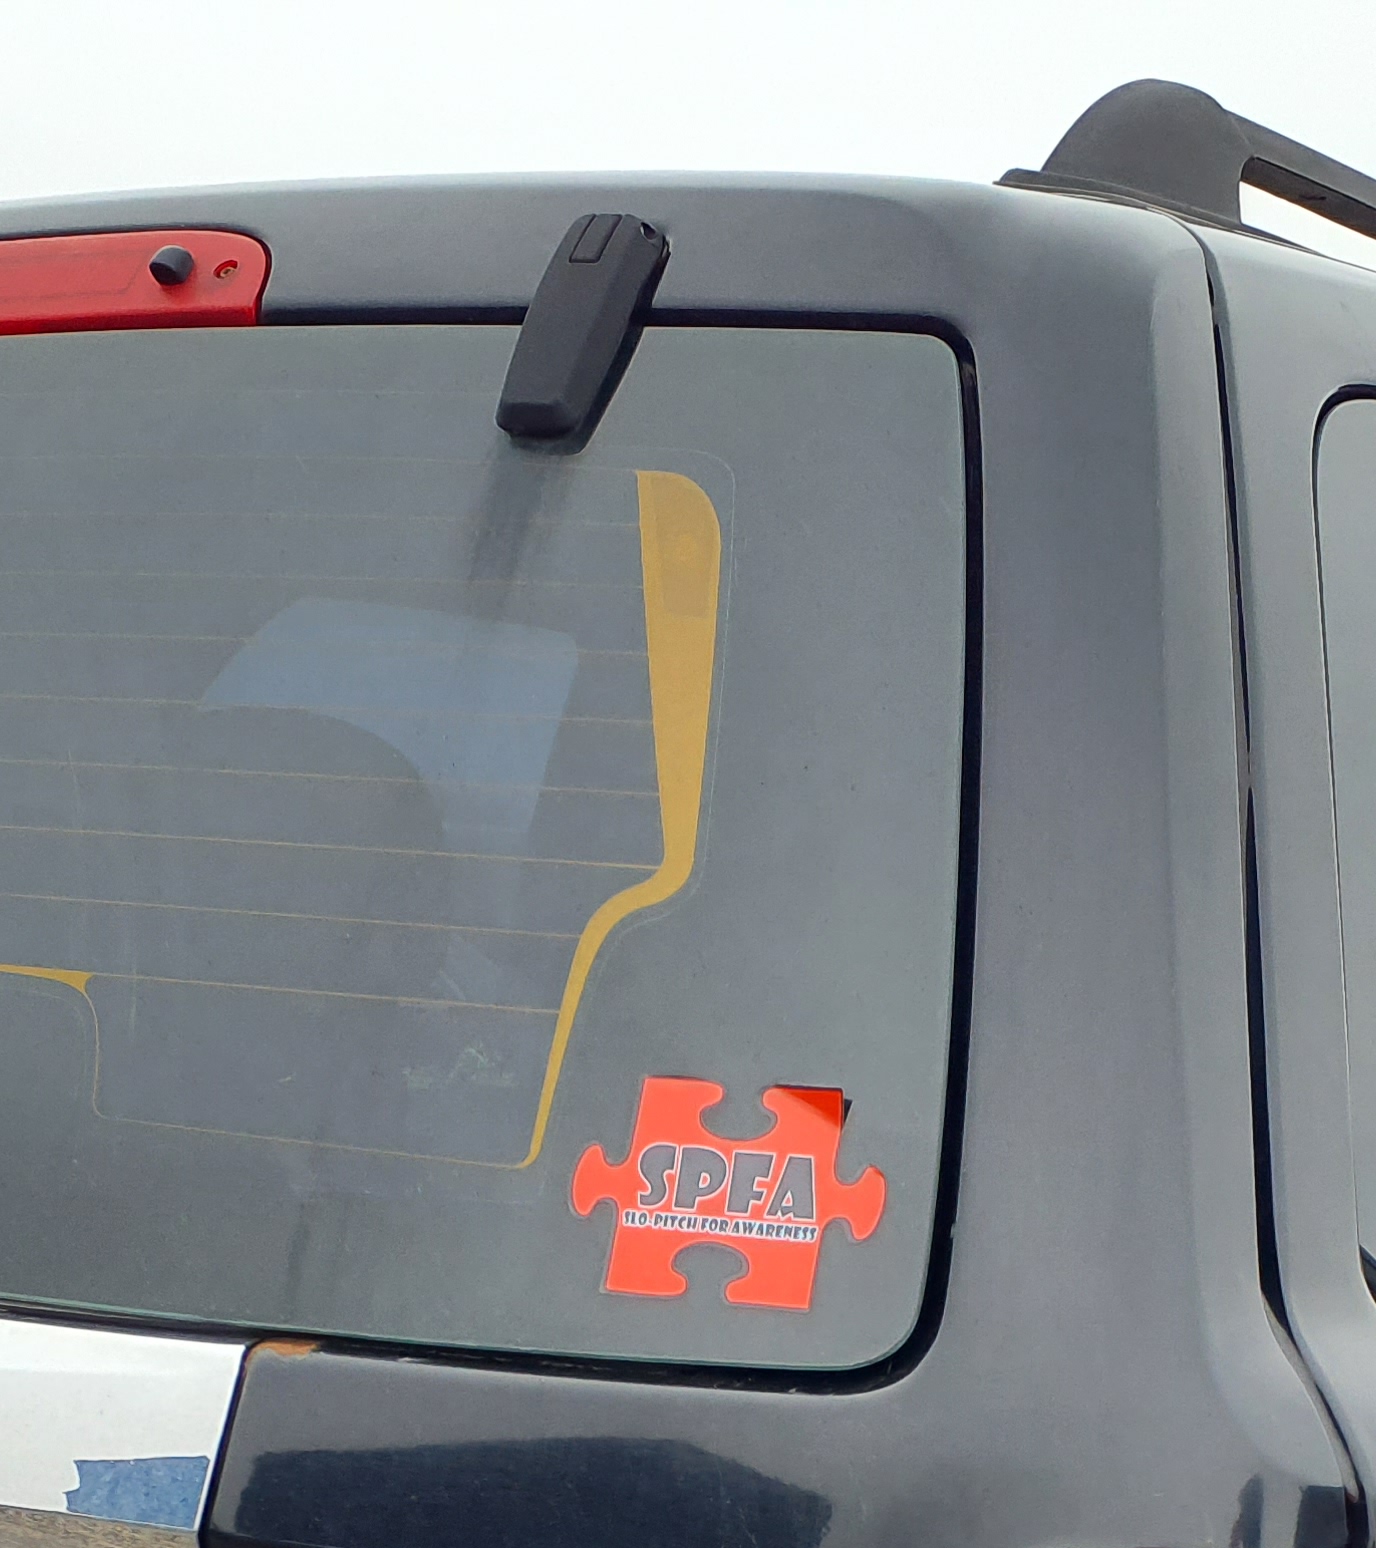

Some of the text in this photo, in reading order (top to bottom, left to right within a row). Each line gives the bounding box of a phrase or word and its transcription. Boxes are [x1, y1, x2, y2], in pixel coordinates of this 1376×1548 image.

[637, 1142, 816, 1221] SPFA
[623, 1210, 817, 1242] SLO-PITCH FOR AWARENESS
